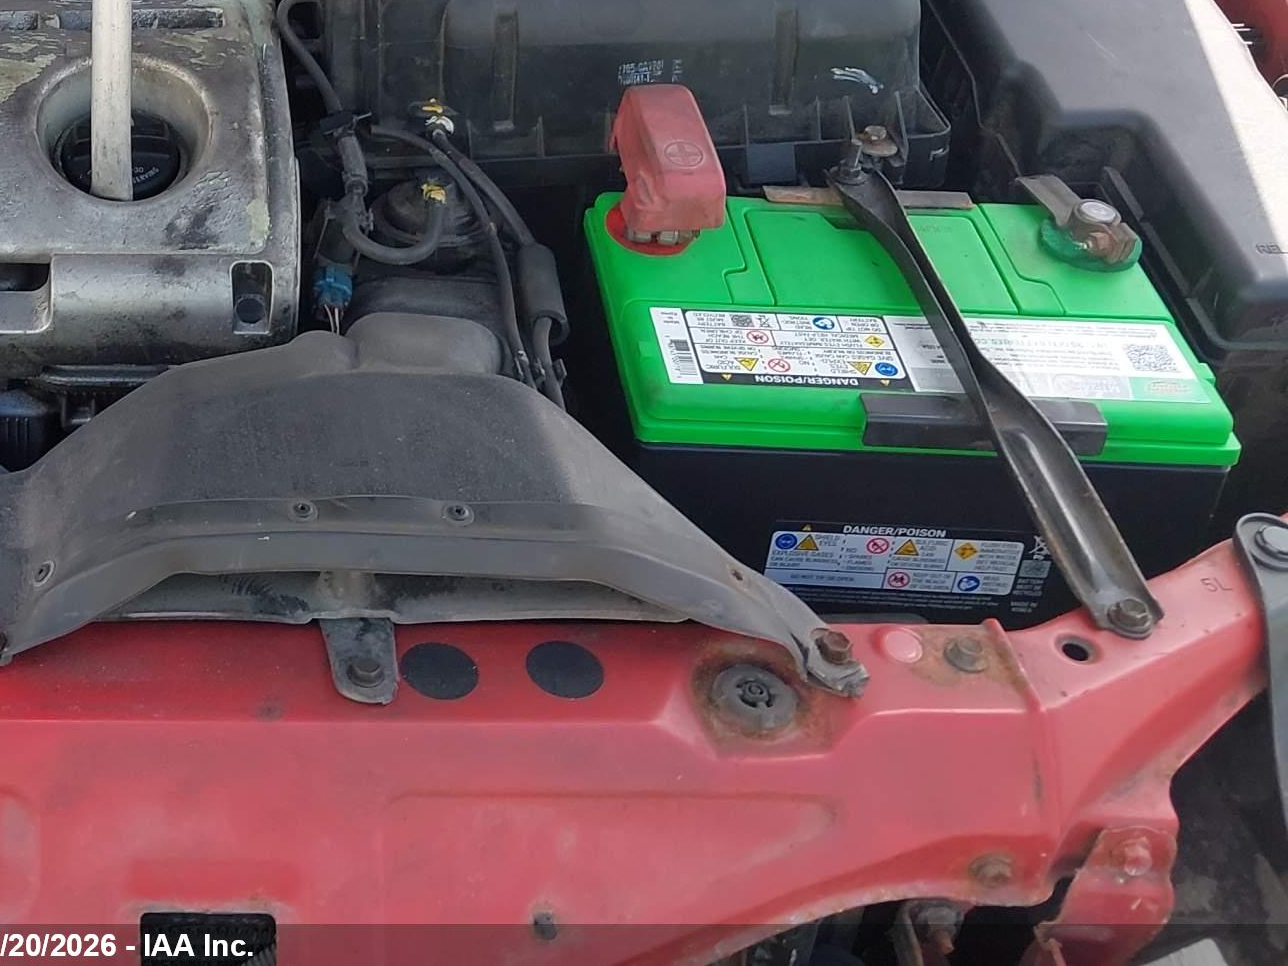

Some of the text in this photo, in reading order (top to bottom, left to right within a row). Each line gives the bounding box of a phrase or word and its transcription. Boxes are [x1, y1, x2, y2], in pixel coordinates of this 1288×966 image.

[755, 375, 859, 386] DANGER/POISON
[842, 524, 946, 538] DANGER/POISON
[1199, 577, 1233, 593] 5L
